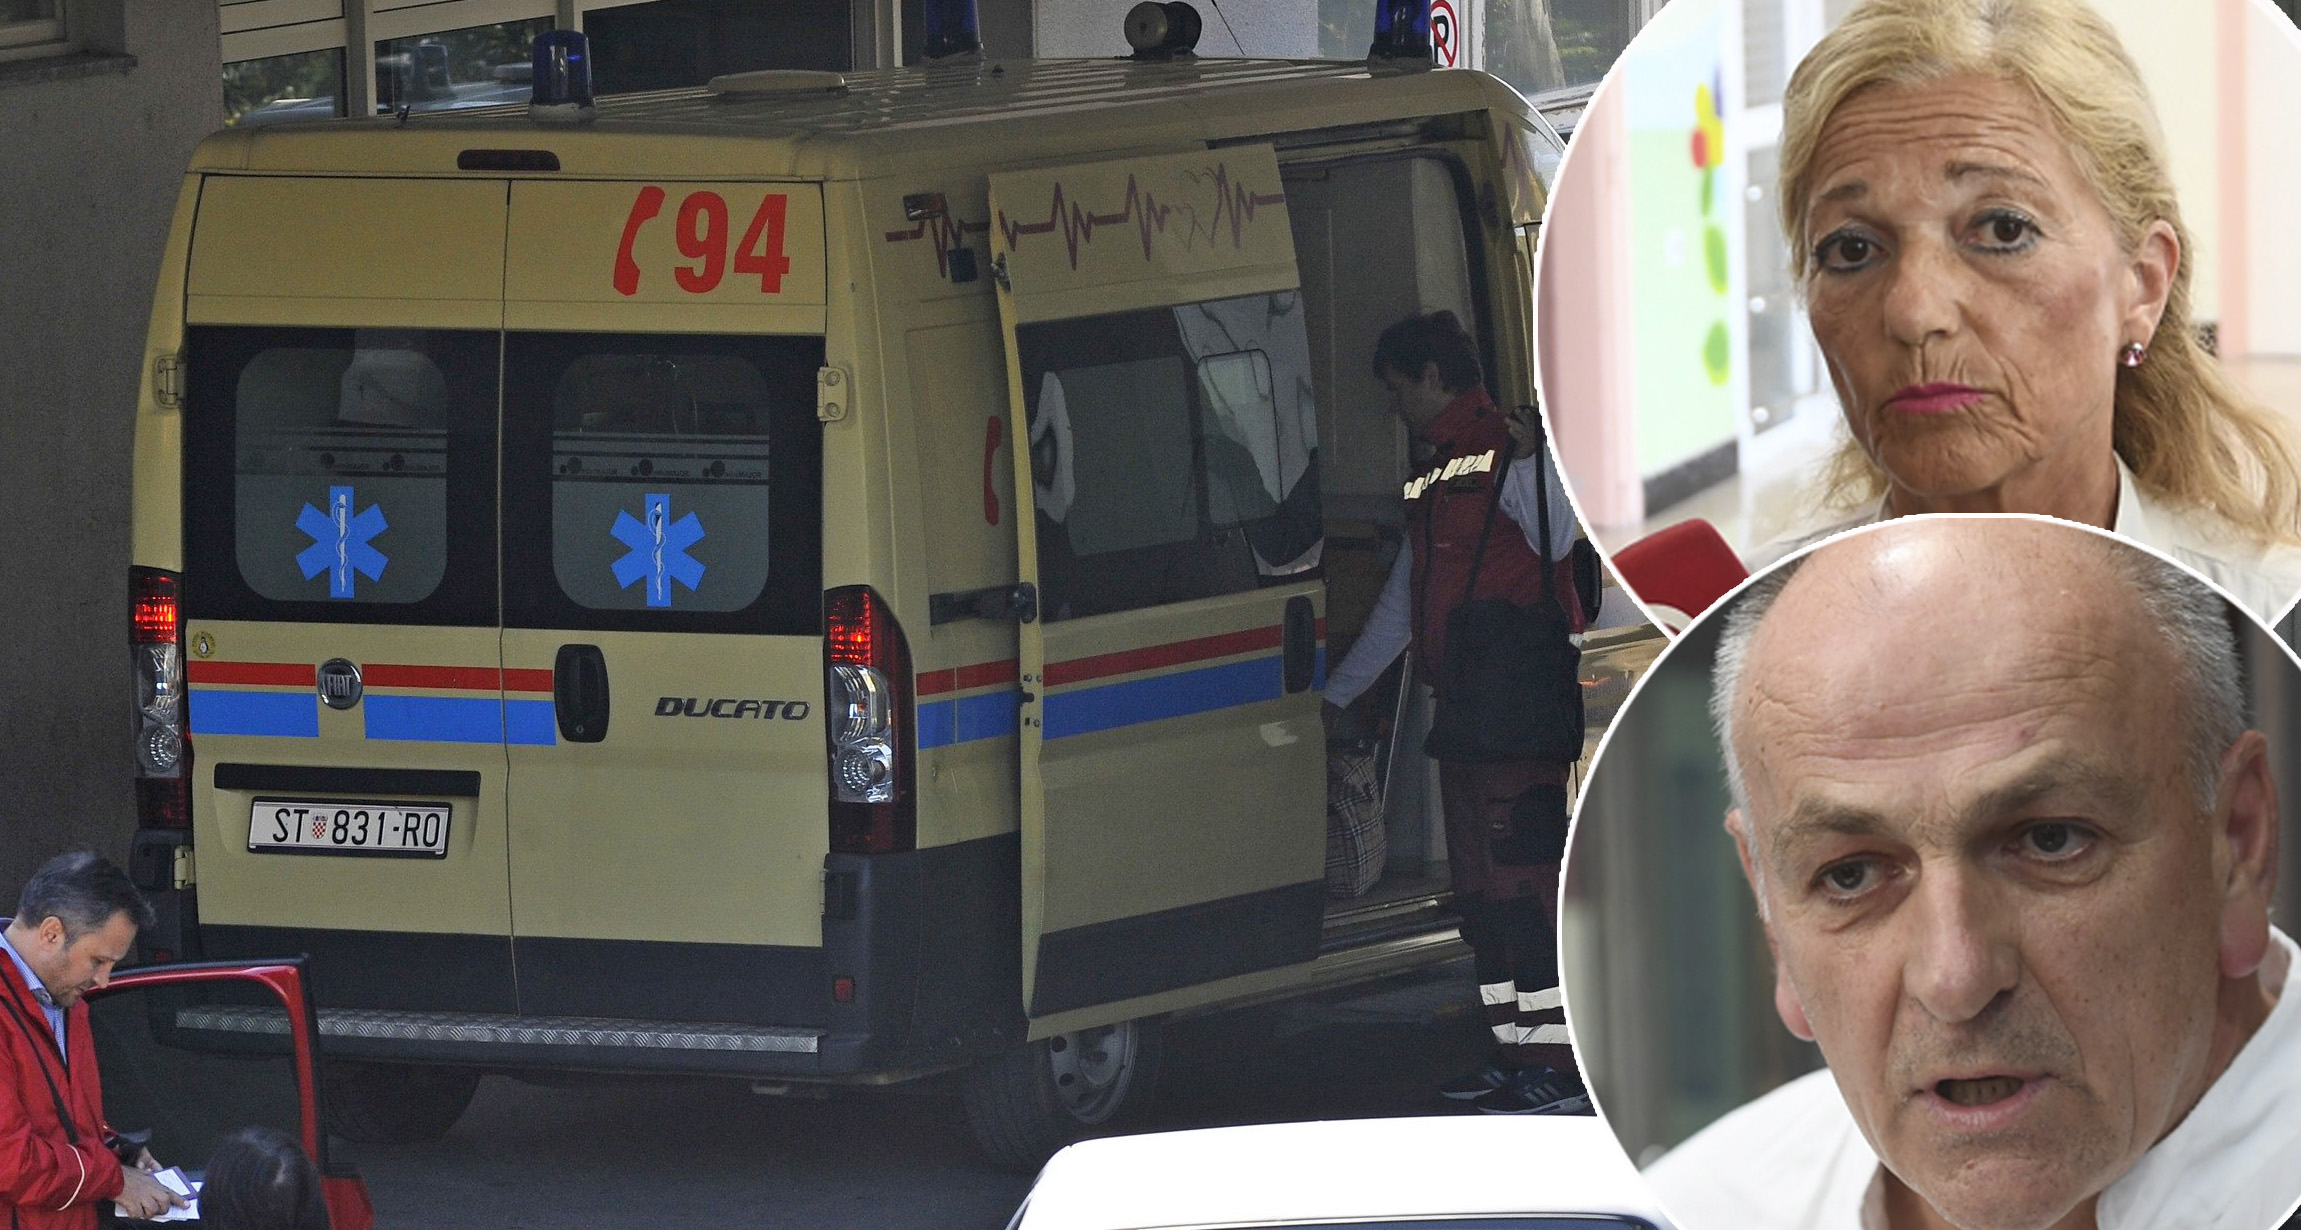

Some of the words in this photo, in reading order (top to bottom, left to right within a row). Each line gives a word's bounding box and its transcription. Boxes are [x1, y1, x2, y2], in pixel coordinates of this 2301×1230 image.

[674, 190, 791, 294] 94
[326, 673, 352, 697] FIAT
[654, 696, 811, 721] DUCATO
[272, 807, 310, 843] ST
[331, 809, 441, 848] 831-RO
